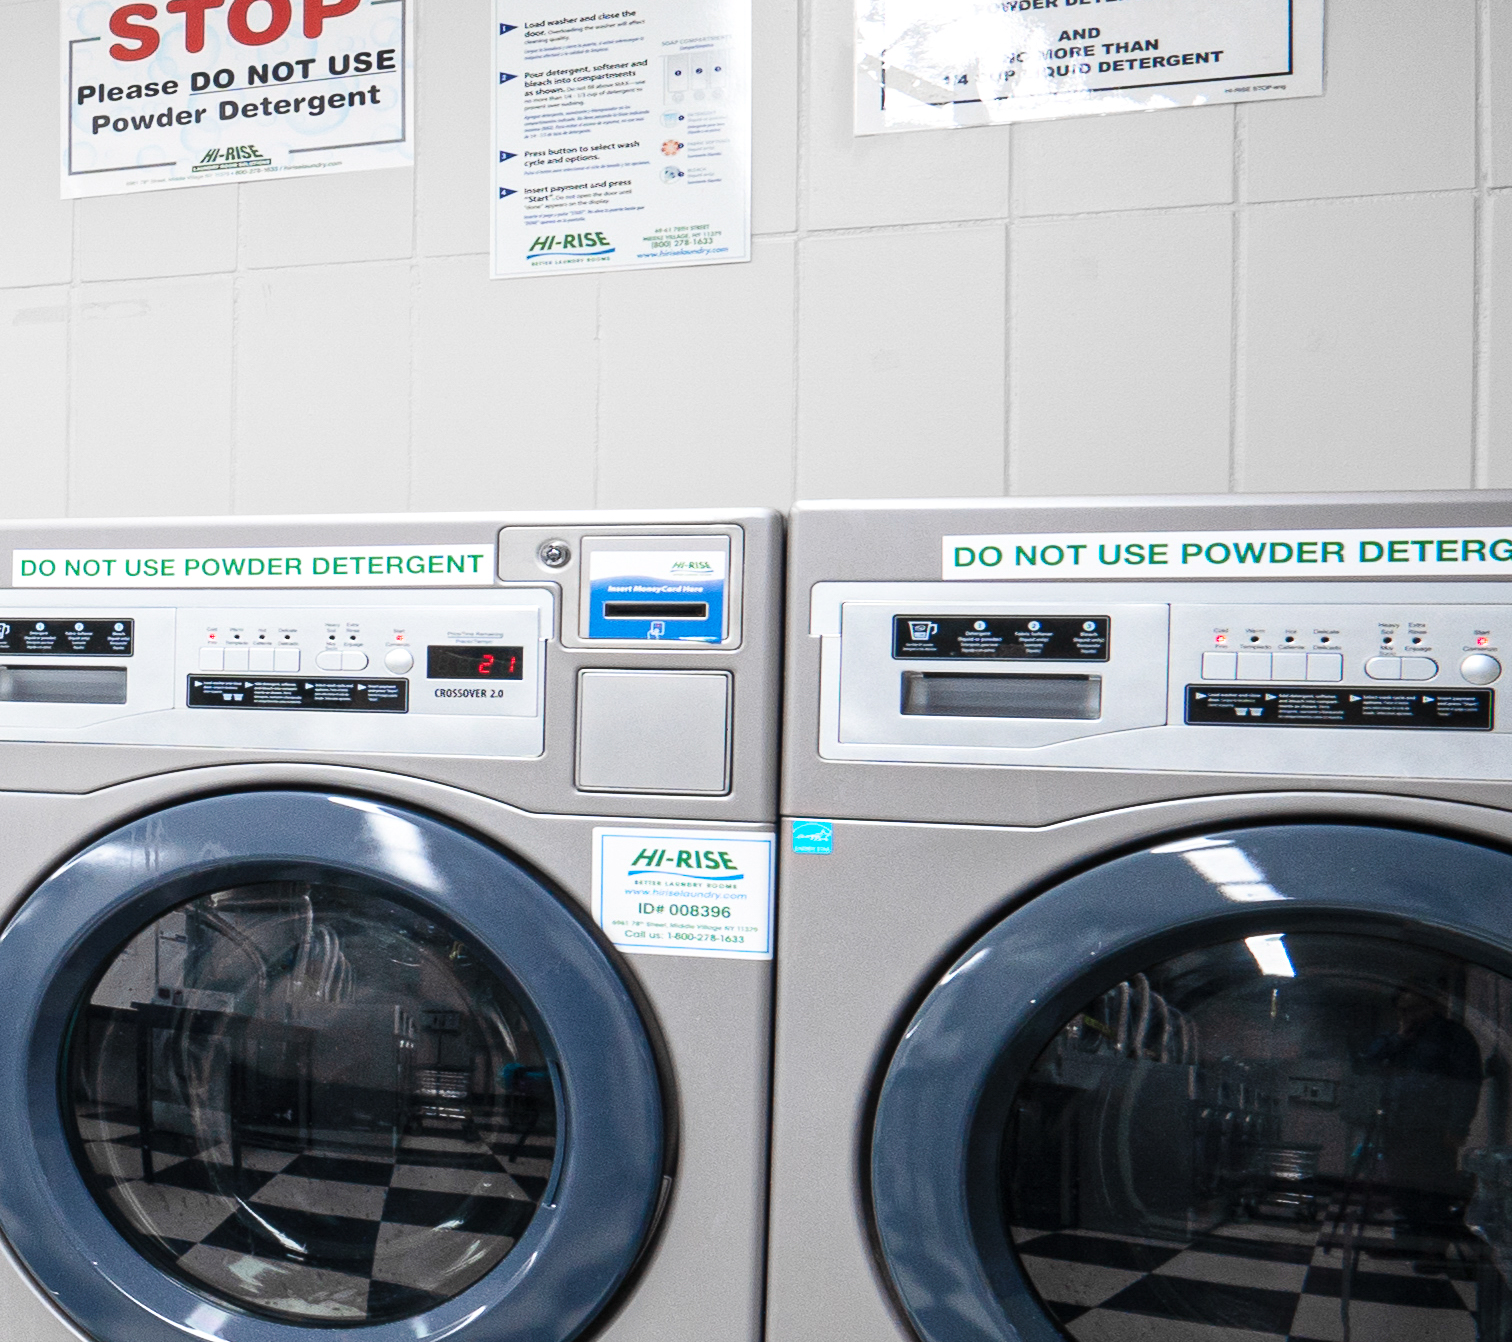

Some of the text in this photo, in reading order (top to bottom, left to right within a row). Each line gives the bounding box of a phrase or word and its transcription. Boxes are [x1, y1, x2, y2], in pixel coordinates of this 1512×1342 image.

[524, 10, 636, 29] Load washer and close the
[1058, 27, 1101, 42] AND
[1102, 39, 1159, 55] THAN
[546, 67, 590, 78] detergent,
[593, 62, 629, 72] softener
[631, 59, 648, 67] and
[1098, 50, 1224, 74] DETERGENT
[77, 48, 397, 105] Please DO NOT USE
[524, 79, 552, 88] bleach
[573, 70, 636, 82] compartments
[92, 84, 381, 134] Powder Detergent
[200, 145, 264, 163] HI-RISE
[548, 146, 577, 155] button
[591, 144, 615, 152] select
[524, 154, 600, 167] cycle and options.
[551, 183, 588, 193] payment
[590, 181, 607, 189] and
[529, 231, 610, 252] HI-RISE
[652, 237, 714, 249] (800) 278-1633
[954, 538, 1512, 567] DO NOT USE POWDER DETERG
[21, 554, 484, 577] DO NOT USE POWDER DETERGENT
[633, 585, 682, 594] MoneyCard
[435, 689, 504, 698] CROSSOVER 2.0
[631, 849, 738, 870] HI-RISE
[625, 888, 747, 900] www.hiriselaundry.com
[638, 903, 731, 918] ID# 008396
[624, 930, 646, 939] Call
[668, 932, 744, 944] 1-800-278-1633
